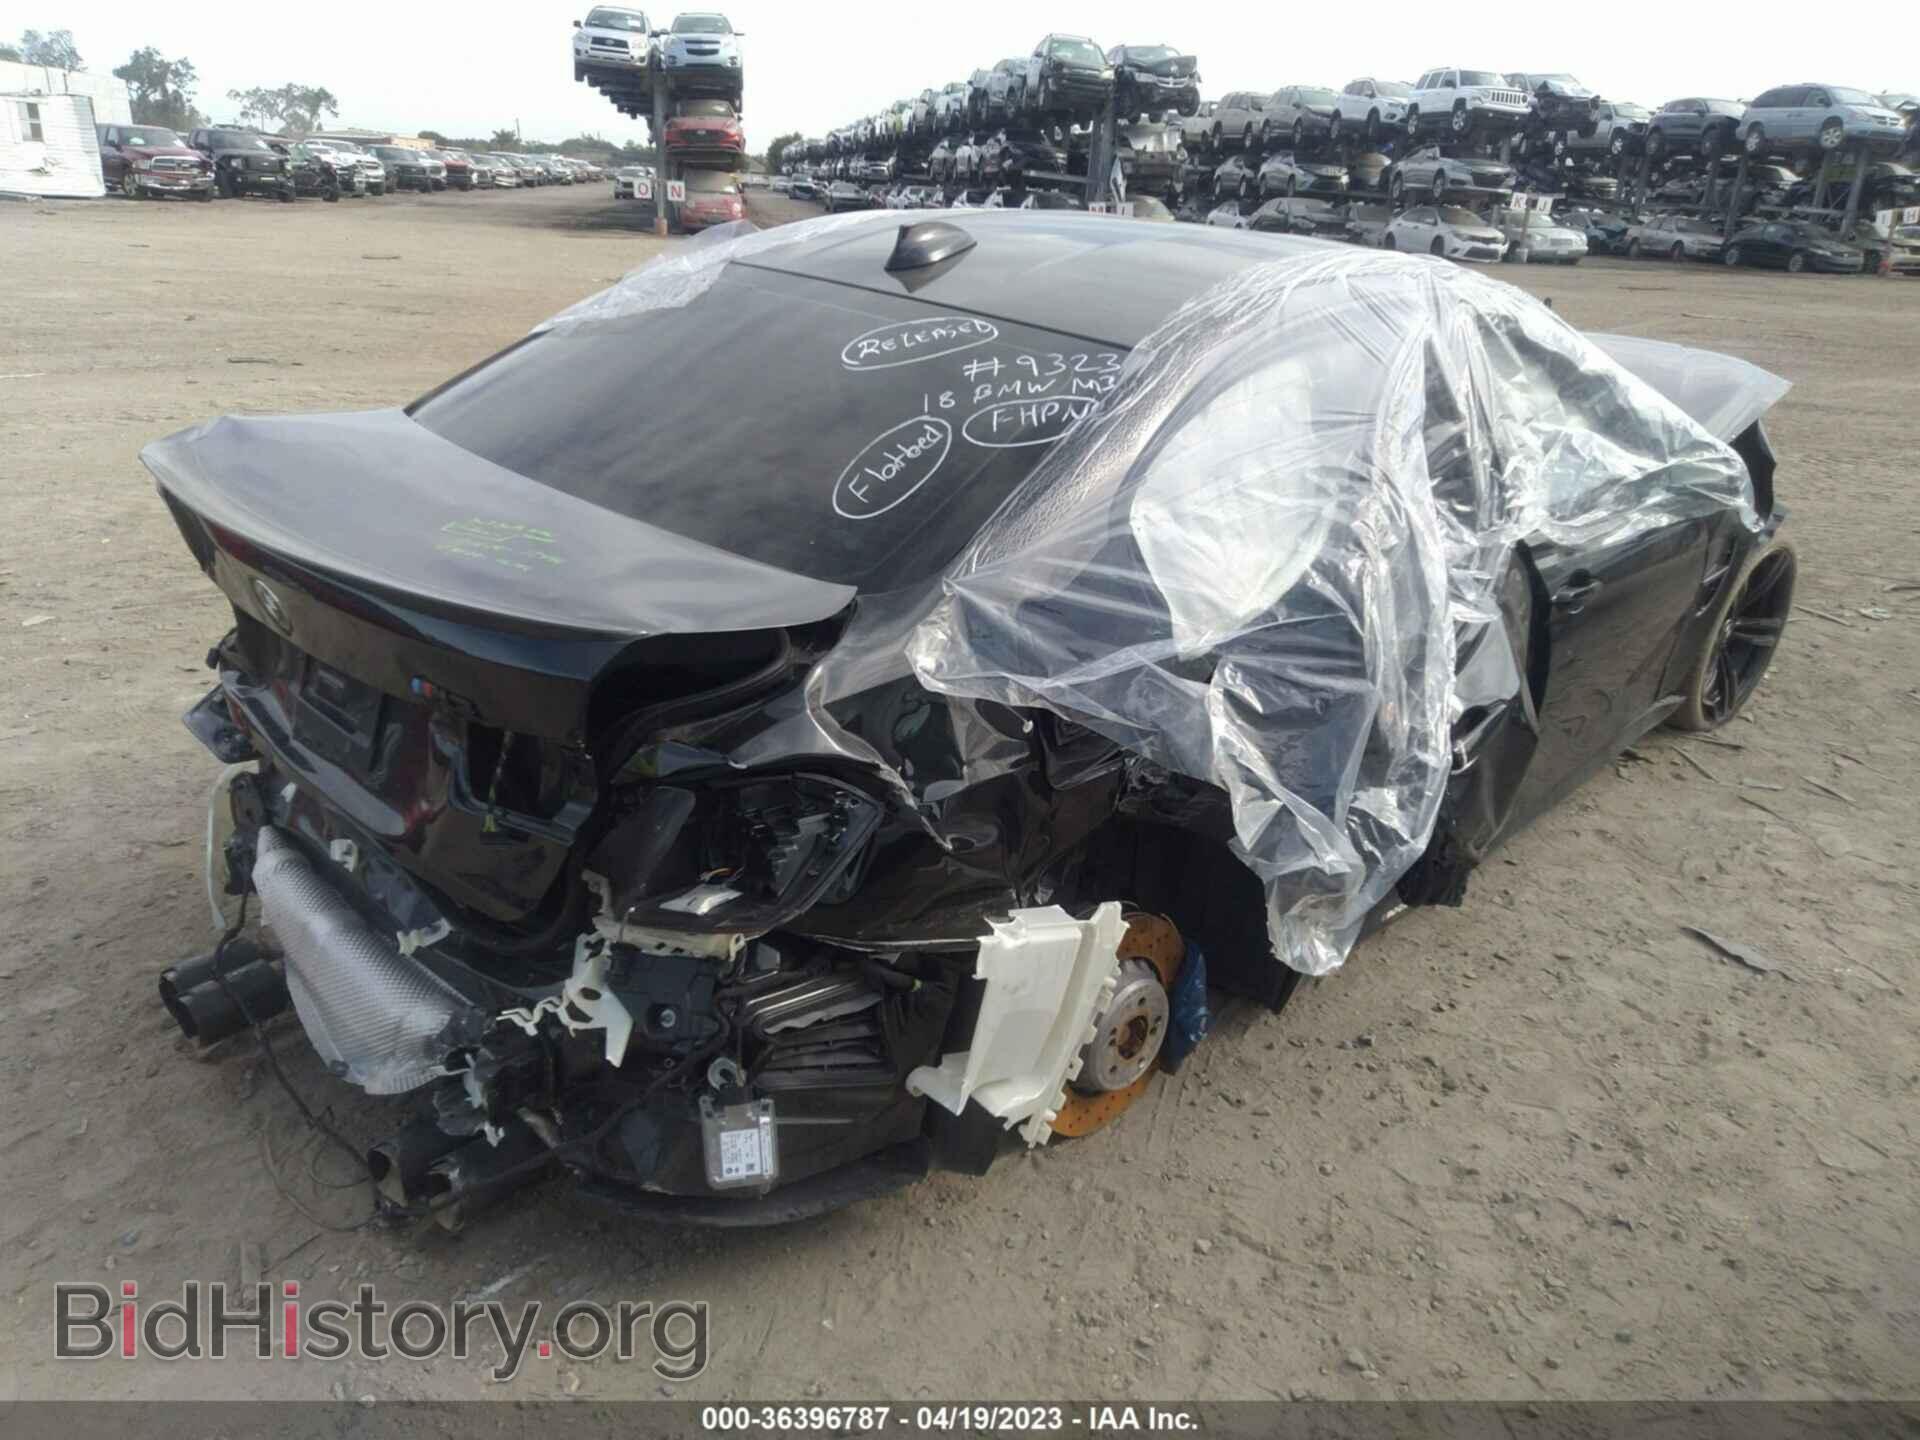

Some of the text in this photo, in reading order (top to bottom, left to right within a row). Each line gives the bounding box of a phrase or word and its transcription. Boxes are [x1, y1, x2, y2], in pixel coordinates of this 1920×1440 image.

[671, 184, 682, 199] N
[857, 319, 992, 359] RELEASED
[973, 378, 1058, 404] BMW
